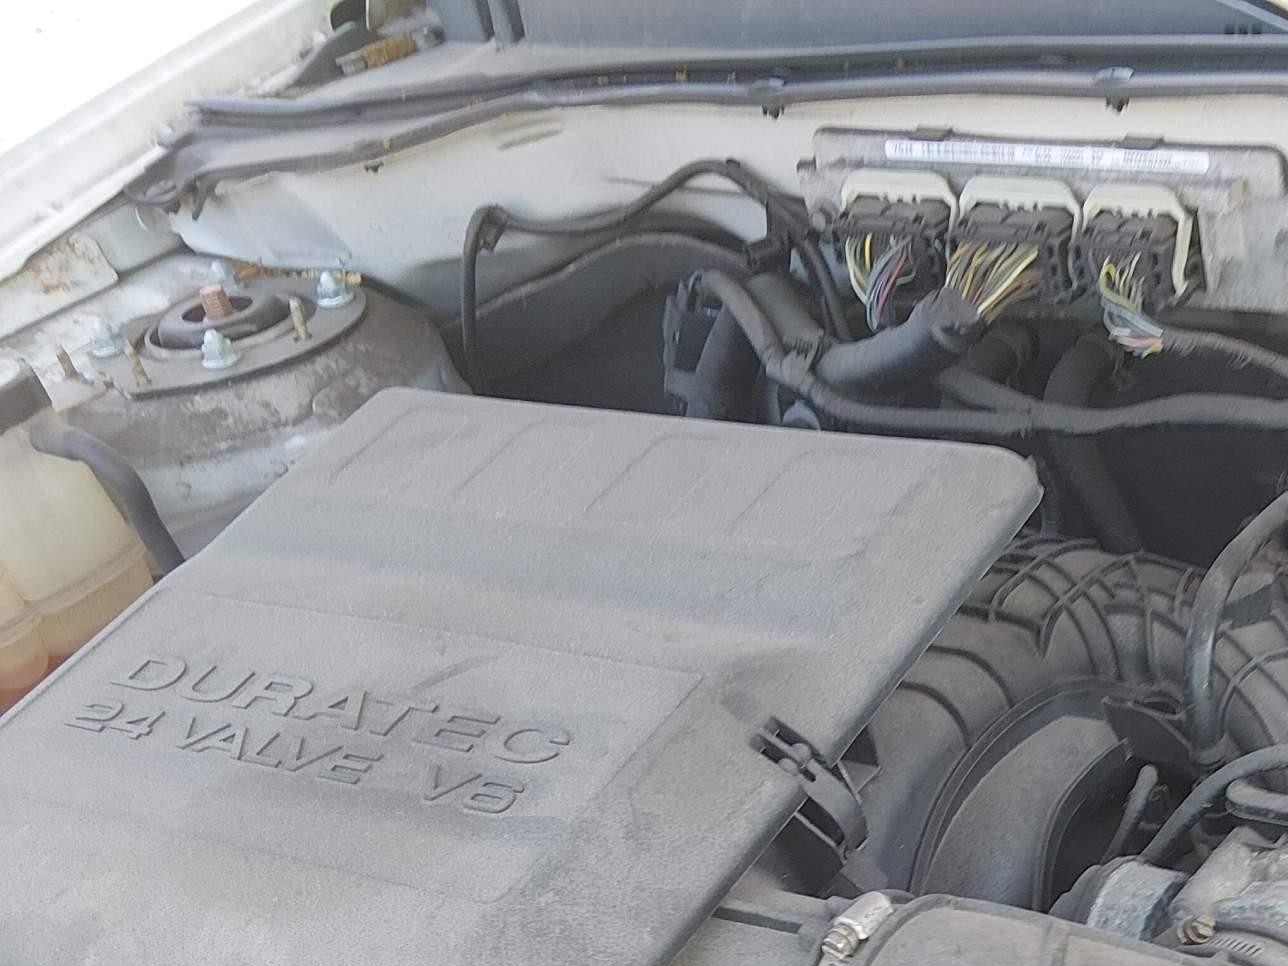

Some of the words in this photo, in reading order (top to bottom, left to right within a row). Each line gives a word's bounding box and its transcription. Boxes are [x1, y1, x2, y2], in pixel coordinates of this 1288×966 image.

[64, 701, 166, 741] 24
[176, 715, 385, 786] VALVE
[111, 659, 571, 764] DURATEC
